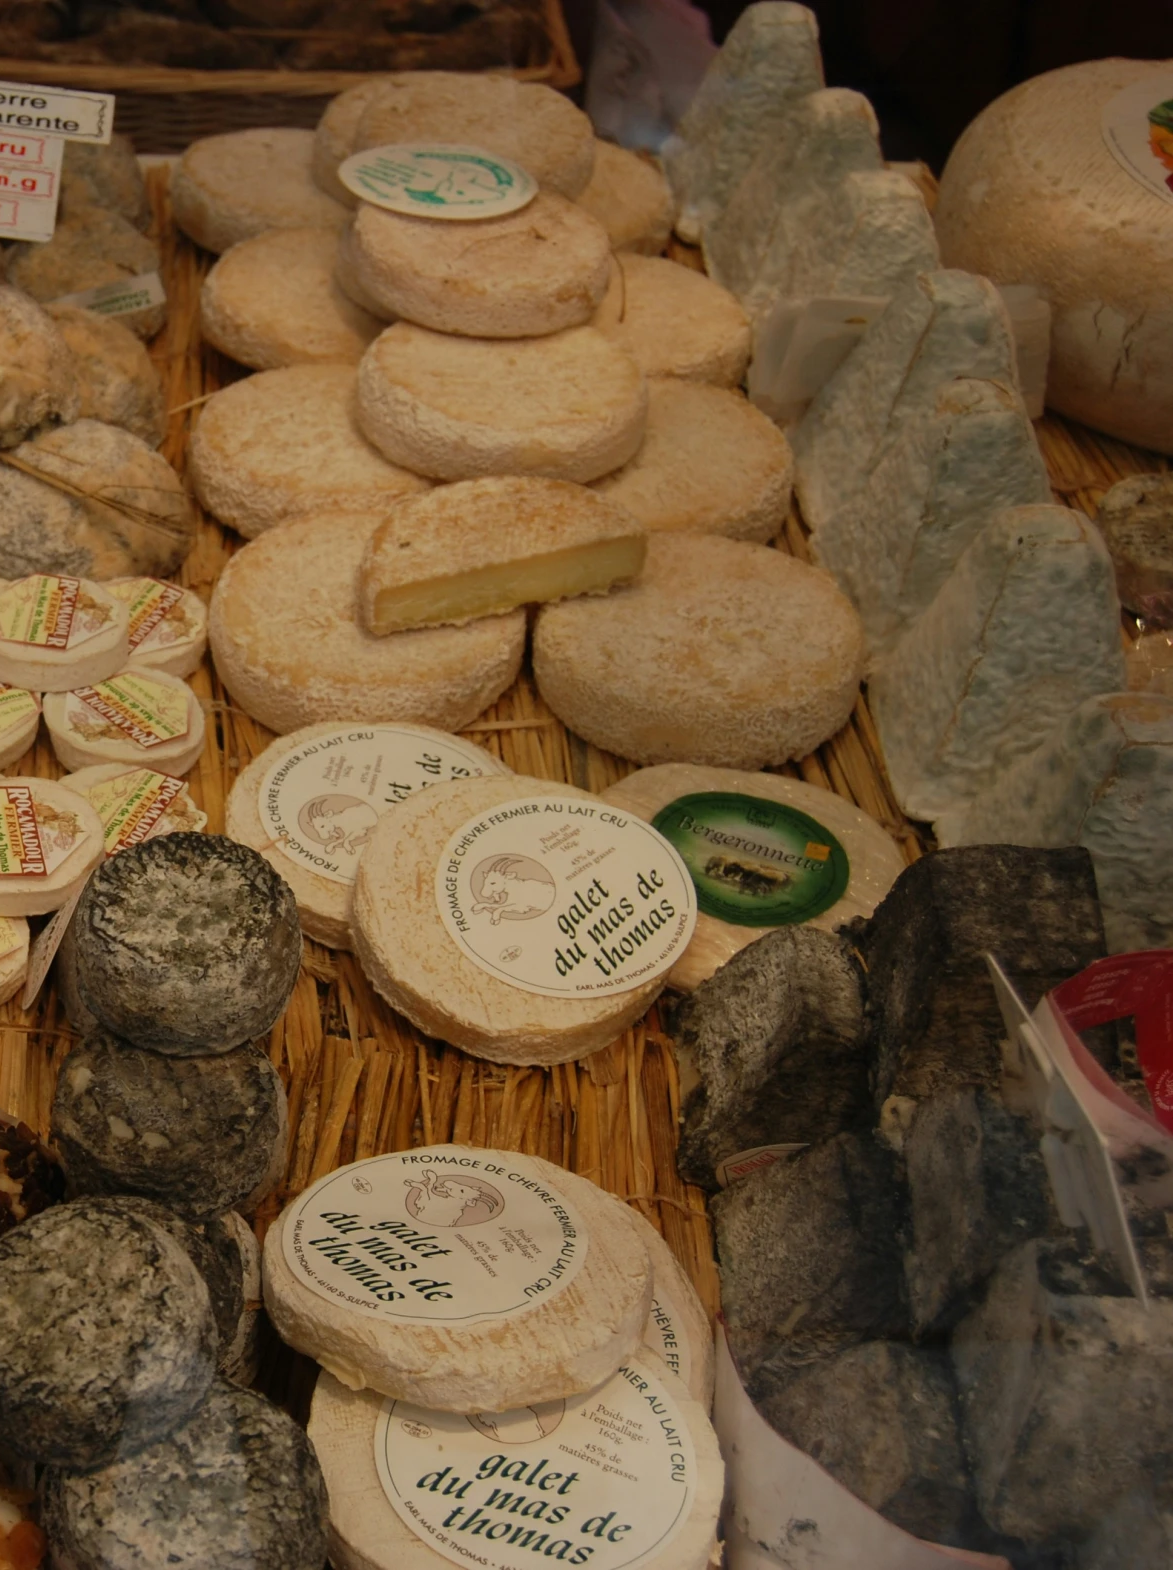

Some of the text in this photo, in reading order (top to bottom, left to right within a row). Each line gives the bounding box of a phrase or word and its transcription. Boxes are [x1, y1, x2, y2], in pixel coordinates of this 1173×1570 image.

[47, 579, 77, 648] ROCAMADOUR
[74, 687, 162, 746] ROCAMADOUR
[266, 732, 374, 823] CHÈVRE FERMIER AU LAIT CRU
[4, 807, 22, 857] FERMIER
[8, 788, 44, 873] ROCAMADOUR
[118, 790, 157, 837] FERMIER
[445, 804, 628, 933] FROMAGE DE CHÈVRE FERMIER AU LAIT CRU
[677, 815, 824, 873] Bergeronnette
[554, 942, 587, 977] du
[587, 897, 635, 945] mas
[636, 869, 664, 900] de
[556, 878, 610, 940] galet
[593, 899, 675, 977] thomas
[575, 983, 596, 992] EARL
[596, 980, 614, 989] MAS
[614, 976, 626, 985] DE
[625, 962, 655, 981] THOMAS
[369, 1221, 453, 1258] galet
[402, 1155, 577, 1298] FROMAGE DE CHÈVRE FERMIER AU LAIT CRU
[296, 1253, 380, 1310] THOMAS St-SULPICE
[308, 1236, 406, 1302] thomas
[319, 1212, 453, 1302] du mas de
[588, 1413, 644, 1444] l'emballage
[596, 1403, 643, 1430] Poids net
[598, 1427, 624, 1446] 160g.
[644, 1395, 686, 1483] AU LAIT CRU
[475, 1454, 580, 1495] galet
[558, 1444, 639, 1484] matières grasses
[585, 1442, 622, 1465] 45% de
[404, 1500, 421, 1519] EARL
[419, 1518, 437, 1534] MAS
[436, 1532, 449, 1544] DE
[449, 1541, 489, 1566] THOMAS
[416, 1466, 632, 1543] du mas de
[442, 1506, 595, 1565] thomas
